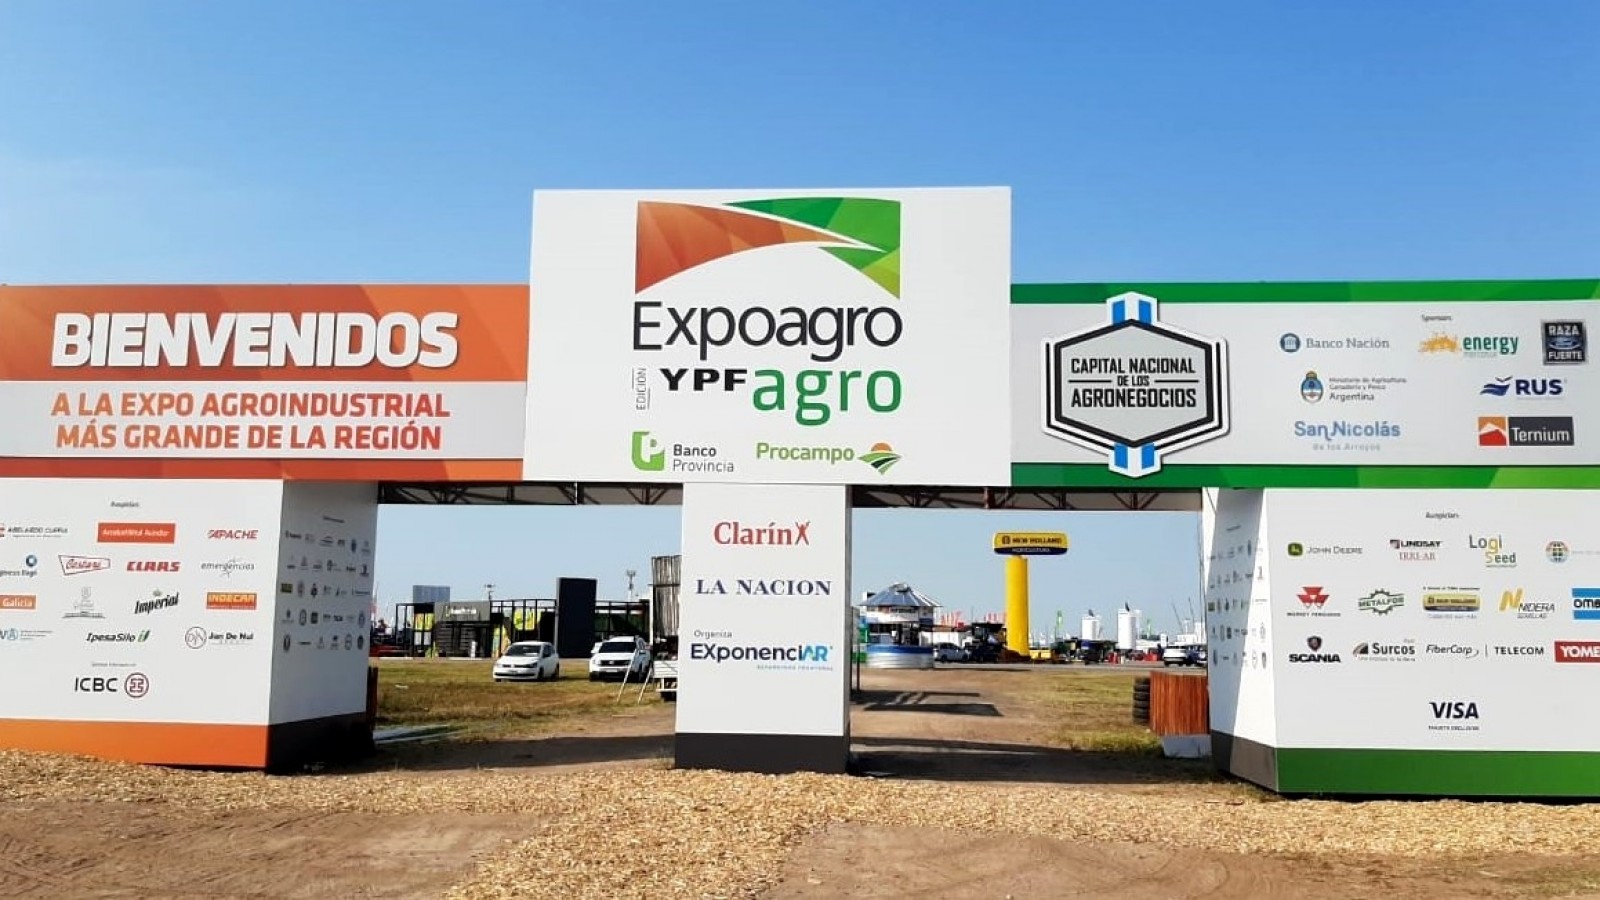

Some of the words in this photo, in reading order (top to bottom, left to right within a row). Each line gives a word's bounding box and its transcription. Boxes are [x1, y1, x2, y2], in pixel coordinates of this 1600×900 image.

[633, 300, 904, 362] Expoagro
[1548, 325, 1580, 336] RAZA
[51, 312, 458, 368] BIENVENIDOS
[1305, 337, 1343, 349] Banco
[1346, 337, 1390, 349] Nación
[1463, 336, 1519, 356] energy
[1548, 351, 1583, 360] FUERTE
[1070, 358, 1125, 374] CAPITAL
[1128, 358, 1196, 374] NACIONAL
[1117, 375, 1129, 387] DE
[1131, 375, 1150, 387] LOS
[1515, 379, 1563, 396] RUS
[659, 368, 748, 391] YPF
[752, 369, 903, 427] agro
[1070, 388, 1197, 408] AGRONEGOCIOS
[1329, 392, 1375, 403] Argentina
[51, 393, 71, 417] A
[79, 393, 113, 417] LA
[121, 393, 194, 417] EXPO
[201, 392, 450, 418] AGROINDUSTRIAL
[56, 419, 117, 450] MÁS
[124, 424, 240, 450] GRANDE
[247, 425, 283, 450] DE
[290, 425, 325, 450] LA
[334, 420, 442, 451] REGIÓN
[1511, 427, 1570, 442] Ternium
[673, 444, 717, 458] Banco
[756, 442, 855, 465] Procampo
[673, 459, 735, 473] Provincia
[207, 529, 259, 540] APACHE
[713, 521, 793, 545] Clarín
[1307, 546, 1332, 555] JOHN
[1333, 546, 1363, 555] DEERE
[1401, 540, 1441, 548] LINDSAY
[1468, 534, 1503, 554] Logi
[1485, 551, 1517, 564] Seed
[126, 561, 182, 572] CLAAS
[696, 579, 728, 595] LA
[736, 579, 832, 596] NACION
[2, 598, 33, 608] Galicia
[134, 592, 180, 614] Imperial
[207, 593, 254, 602] INDECAR
[1357, 596, 1405, 608] METALFOR
[1518, 602, 1556, 613] NIDERA
[208, 632, 224, 640] Jan
[225, 632, 237, 640] De
[239, 632, 254, 640] Nul
[693, 630, 733, 640] Organiza
[690, 643, 829, 664] EXponenciAR
[1371, 643, 1416, 655] Surcos
[1425, 644, 1473, 656] FiberCorp
[1494, 646, 1544, 655] TELECOM
[1288, 653, 1342, 663] SCANIA
[74, 677, 118, 693] ICBC
[1428, 701, 1479, 719] VISA
